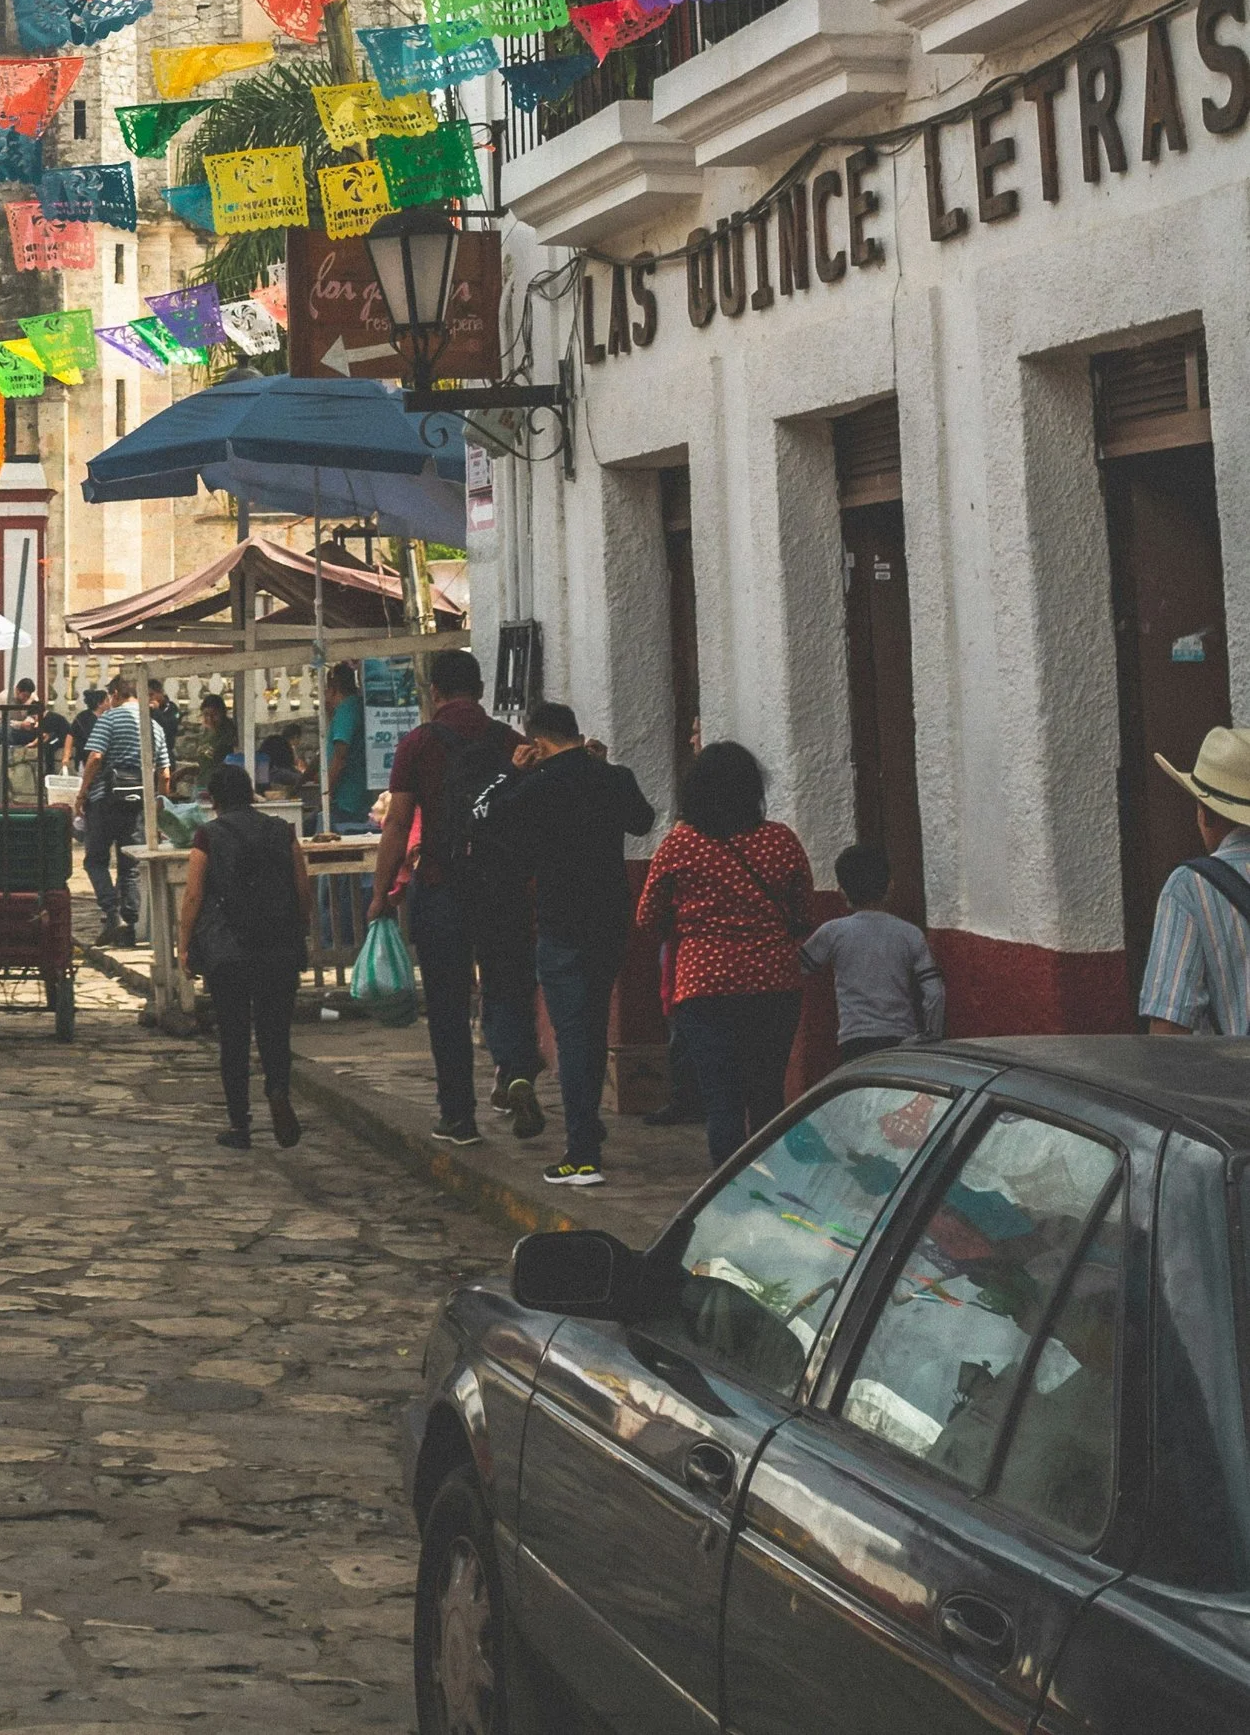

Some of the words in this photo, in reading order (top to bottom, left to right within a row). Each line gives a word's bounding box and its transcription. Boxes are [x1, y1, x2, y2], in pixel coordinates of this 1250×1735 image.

[309, 251, 358, 320] los
[582, 249, 657, 365] LAS
[686, 147, 885, 329] QUINCE
